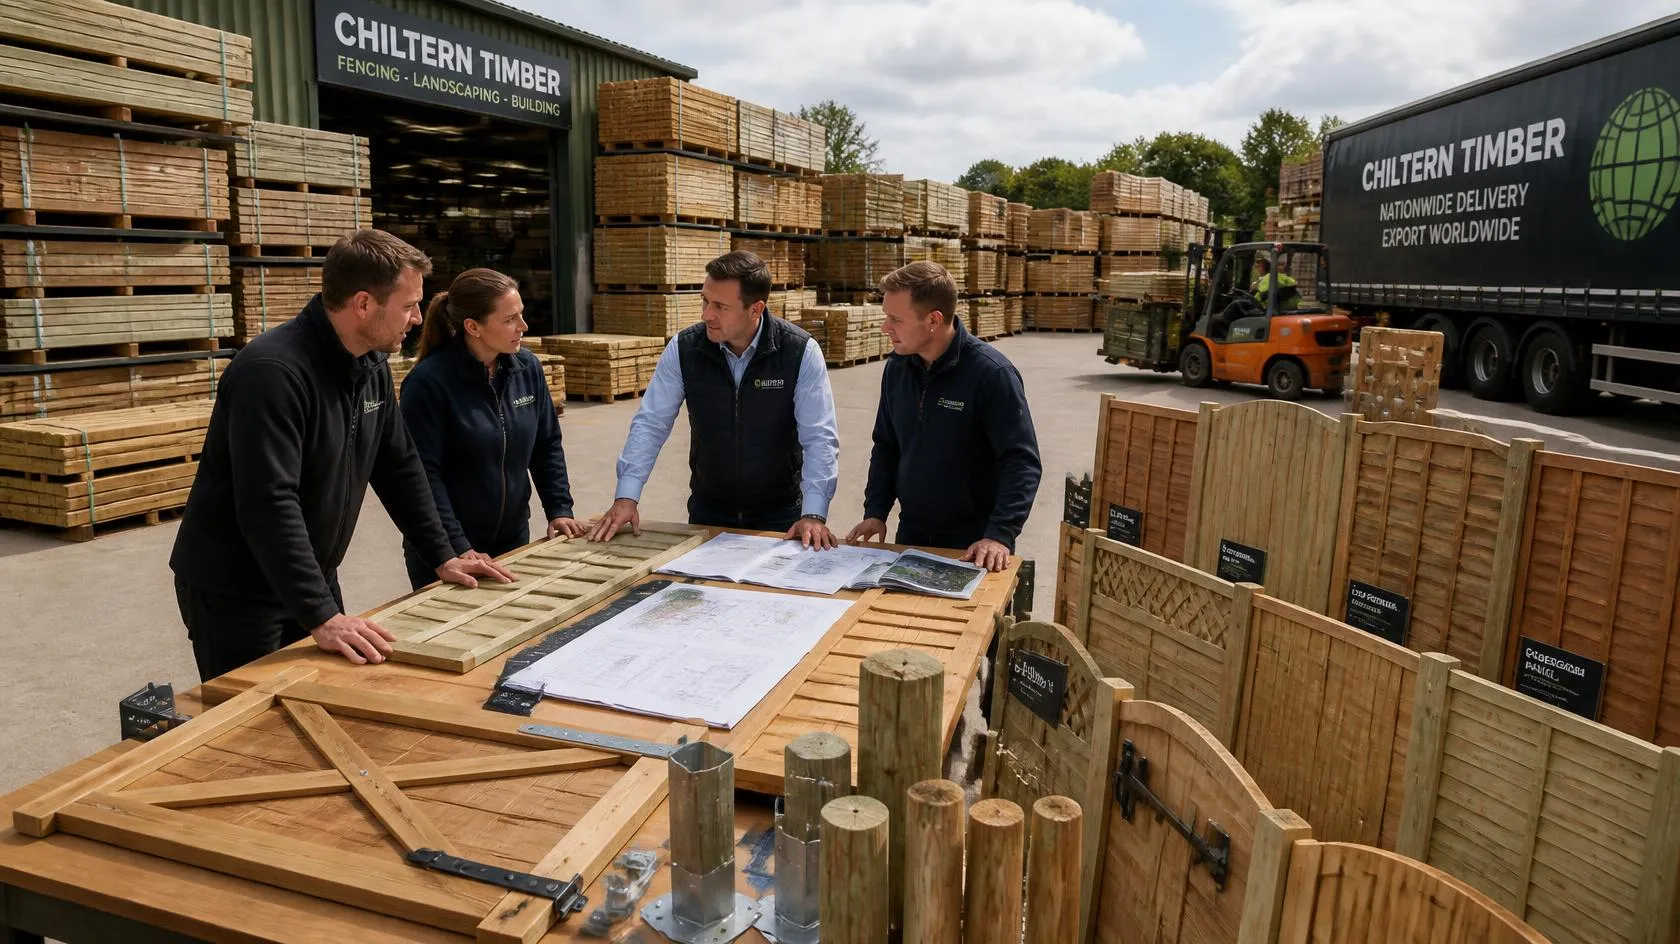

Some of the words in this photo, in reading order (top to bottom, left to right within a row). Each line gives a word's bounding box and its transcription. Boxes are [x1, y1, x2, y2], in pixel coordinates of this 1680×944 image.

[334, 12, 473, 75] CHILTERN
[480, 50, 561, 96] TIMBER
[337, 55, 400, 82] FENCING
[413, 72, 500, 104] LANDSCAPING
[511, 94, 560, 116] BUILDING
[1362, 143, 1455, 191] CHILTERN
[1461, 117, 1566, 173] TIMBER
[1379, 193, 1453, 222] NATIONWIDE
[1456, 182, 1530, 214] DELIVERY
[1382, 225, 1427, 248] EXPORT
[1429, 216, 1521, 245] WORLDWIDE
